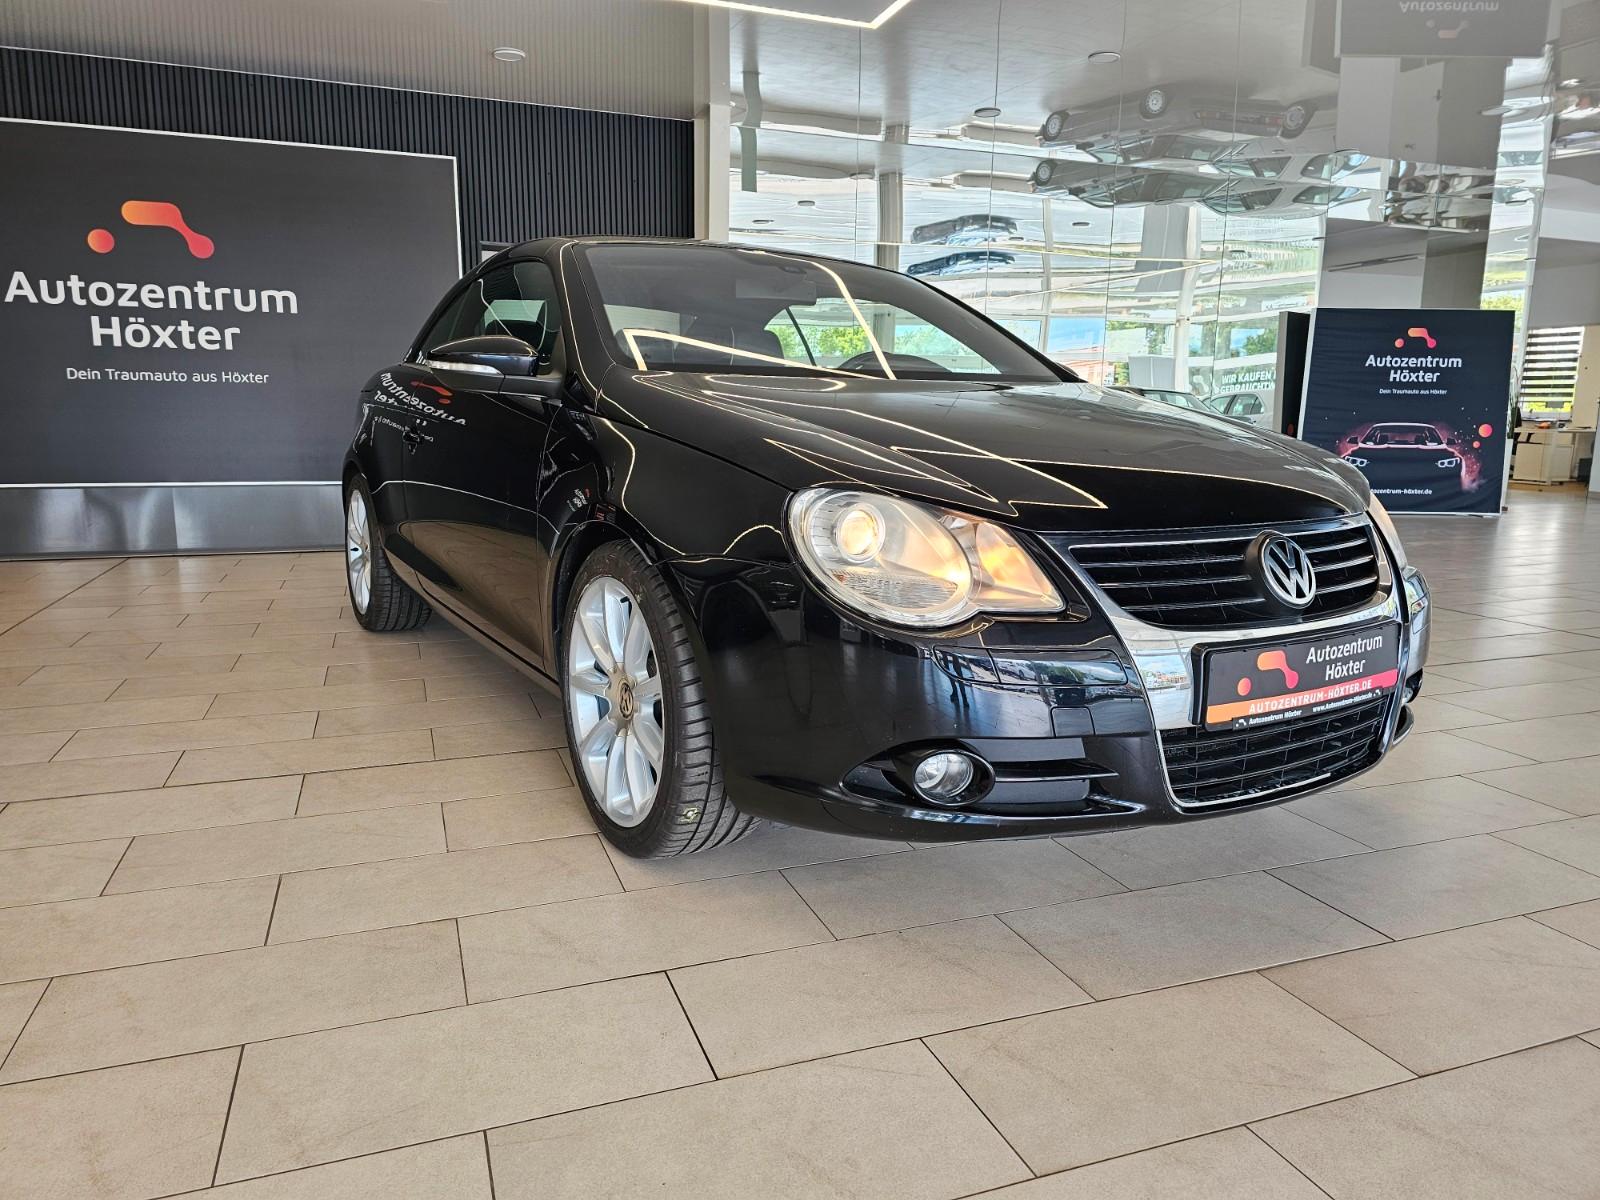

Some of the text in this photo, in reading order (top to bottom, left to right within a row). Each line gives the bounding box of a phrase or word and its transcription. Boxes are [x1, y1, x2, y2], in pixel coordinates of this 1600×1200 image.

[4, 270, 299, 314] Autozentrum
[90, 315, 241, 350] Höxter
[1365, 354, 1463, 368] Autozentrum
[66, 367, 269, 384] Dein Traumauto aus Höxter
[1221, 374, 1238, 385] WIR
[1239, 370, 1272, 383] KAUFEN
[1389, 369, 1440, 383] Höxter
[1262, 536, 1317, 606] VW
[1306, 635, 1383, 665] Autozentrum
[1325, 658, 1366, 681] Höxter
[1248, 679, 1373, 715] AUTOZENTRUM-HÖXTER.DE
